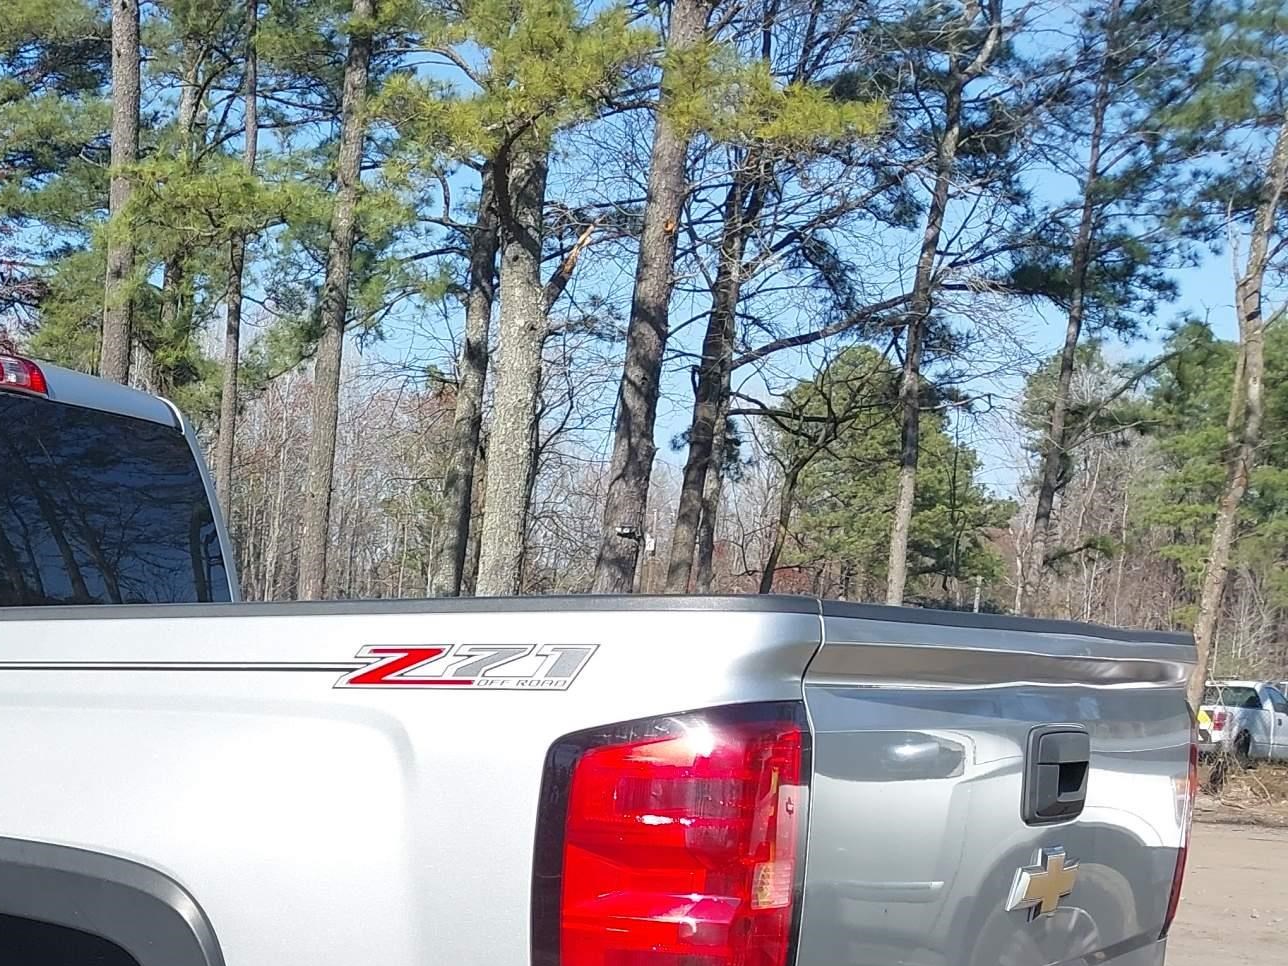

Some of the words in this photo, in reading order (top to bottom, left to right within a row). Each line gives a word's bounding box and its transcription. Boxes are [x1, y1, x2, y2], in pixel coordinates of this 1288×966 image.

[334, 644, 600, 689] Z71
[476, 679, 511, 687] OFF
[516, 679, 568, 687] ROAD
